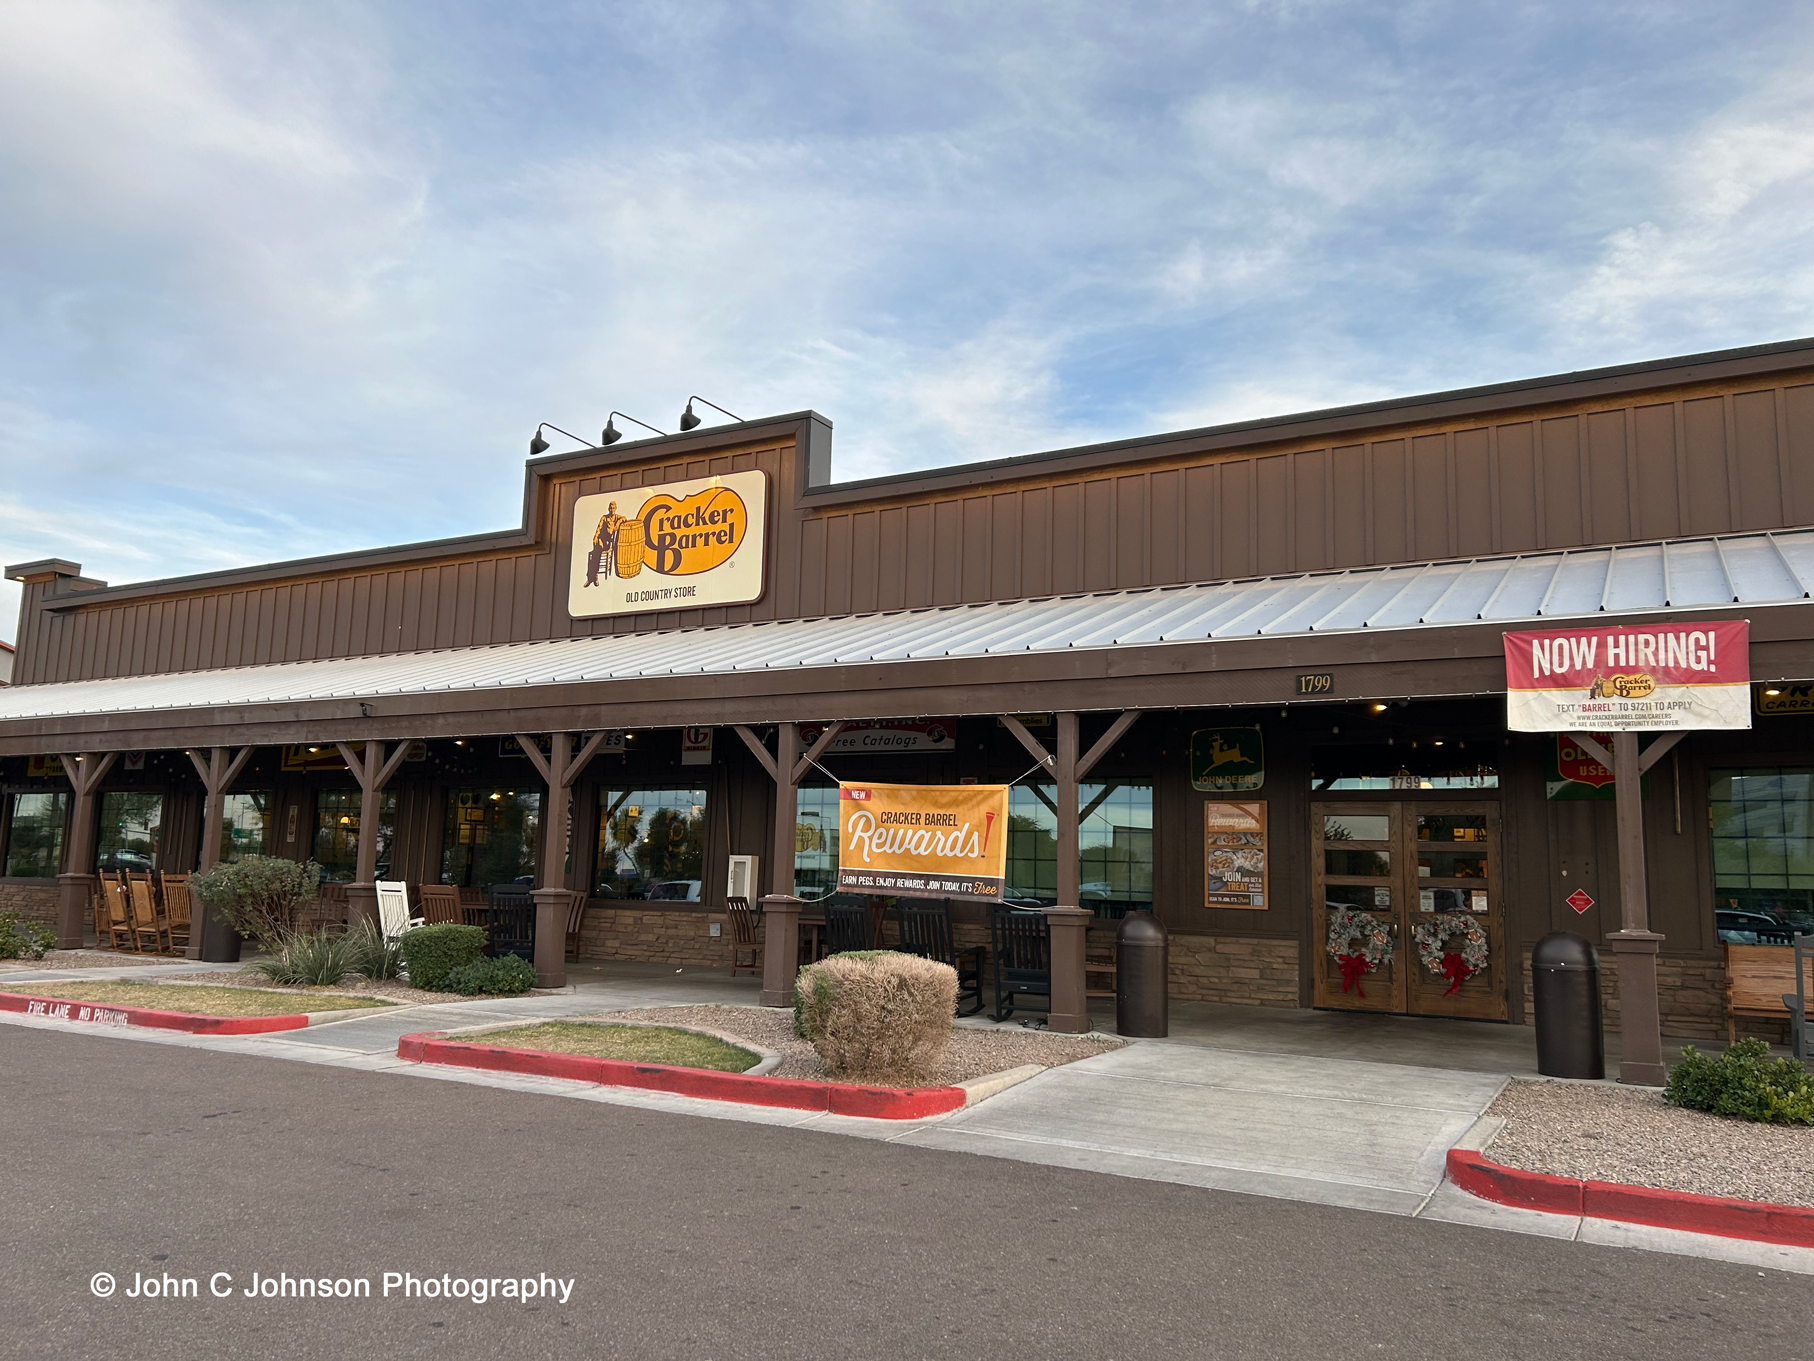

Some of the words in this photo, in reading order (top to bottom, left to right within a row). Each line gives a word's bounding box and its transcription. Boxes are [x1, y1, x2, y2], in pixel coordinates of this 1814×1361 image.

[643, 504, 734, 550] Cracker
[657, 523, 734, 573] Barrel
[626, 591, 639, 603] OLD
[640, 588, 673, 602] COUNTRY
[674, 585, 697, 598] STORE
[1532, 636, 1597, 679] NOW
[1607, 631, 1716, 672] HIRING!
[1300, 675, 1331, 693] 1799
[1613, 676, 1650, 690] Cracker
[1619, 684, 1651, 697] Barrel
[1557, 704, 1575, 713] TEXT
[1618, 703, 1629, 711] TO
[1631, 702, 1652, 711] 97211
[1654, 702, 1665, 711] TO
[1667, 701, 1693, 711] APPLY
[1766, 700, 1814, 709] CARR
[584, 734, 622, 747] TES
[832, 738, 856, 747] ree
[863, 734, 918, 748] Catalogs
[1197, 776, 1222, 784] JOHN
[1225, 775, 1258, 783] DEERE
[1390, 776, 1421, 789] 1799
[851, 790, 866, 799] NEW
[880, 811, 921, 825] CRACKER
[924, 813, 958, 827] BARREL
[1222, 872, 1241, 882] JOIN
[842, 875, 857, 885] EARN
[858, 876, 874, 886] PEGS.
[876, 877, 895, 887] ENJOY
[897, 878, 925, 889] REWARDS.
[926, 880, 939, 890] JOIN
[942, 881, 960, 892] TODAY,
[961, 883, 972, 892] IT'S
[973, 881, 998, 895] Free
[1227, 882, 1248, 891] TREAT
[28, 1001, 46, 1016] FIRE
[49, 1003, 71, 1018] LANE
[78, 1006, 91, 1021] NO
[94, 1008, 128, 1025] PARKING
